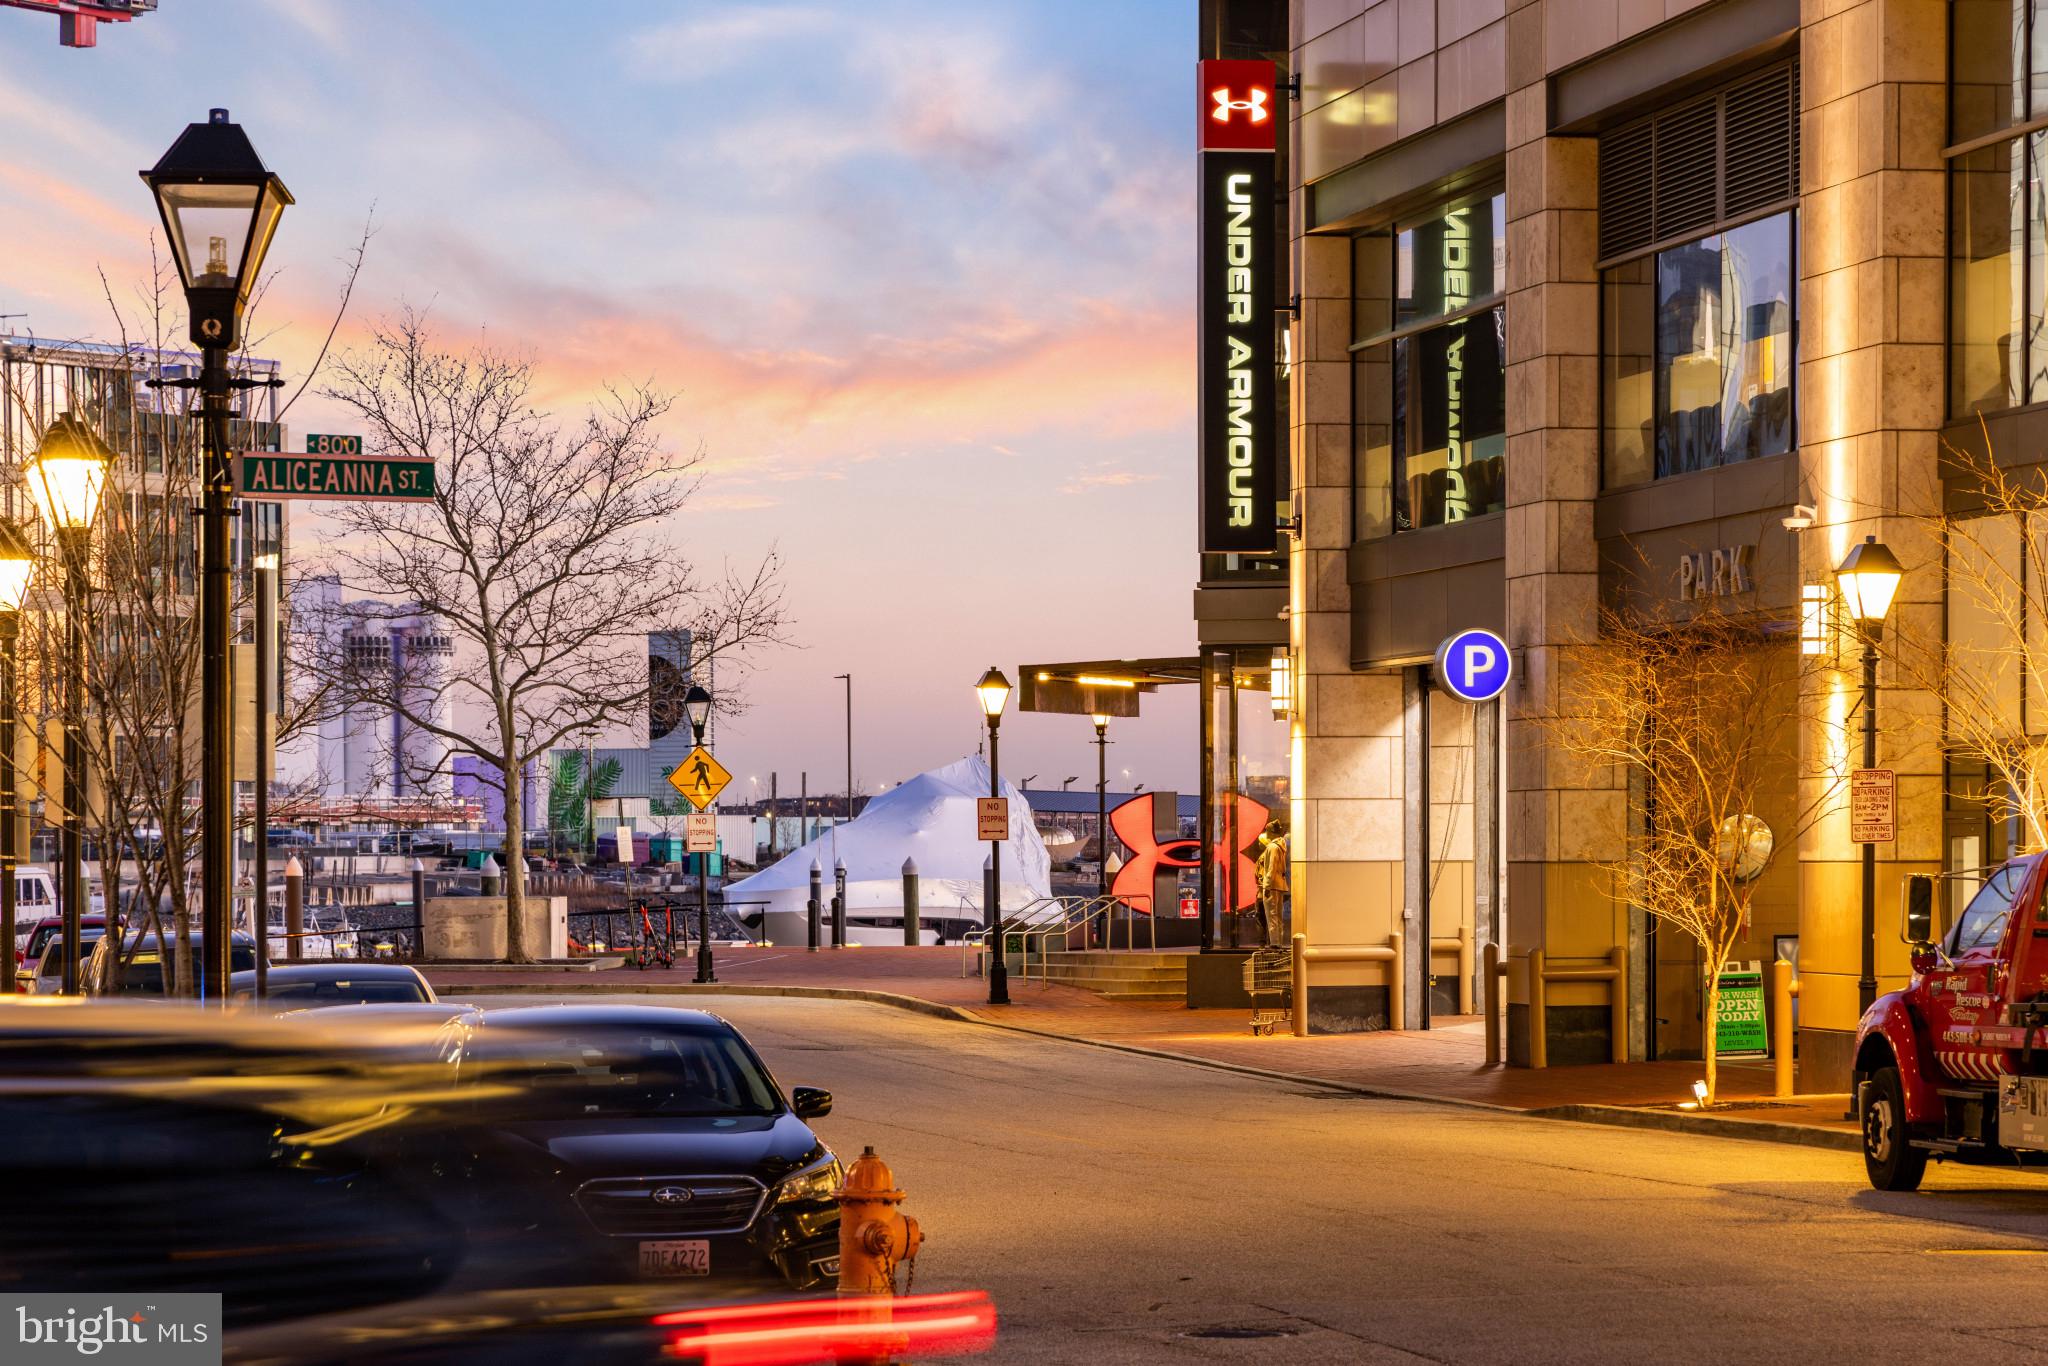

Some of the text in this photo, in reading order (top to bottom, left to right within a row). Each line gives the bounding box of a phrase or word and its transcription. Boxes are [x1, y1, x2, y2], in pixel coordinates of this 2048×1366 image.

[1227, 174, 1252, 527] UNDER ARMOUR
[317, 435, 358, 455] 800
[251, 460, 422, 494] ALICEANNA ST.
[1681, 545, 1748, 601] PARK
[1464, 644, 1496, 687] P
[1861, 788, 1890, 796] PARKING
[987, 802, 999, 811] NO
[695, 817, 708, 825] NO
[980, 815, 1006, 823] STOPPING
[1945, 976, 1968, 994] Rapid
[1731, 990, 1759, 999] WASH
[1955, 992, 1981, 1008] Rescue
[1716, 999, 1760, 1012] OPEN
[1716, 1011, 1761, 1023] TODAY
